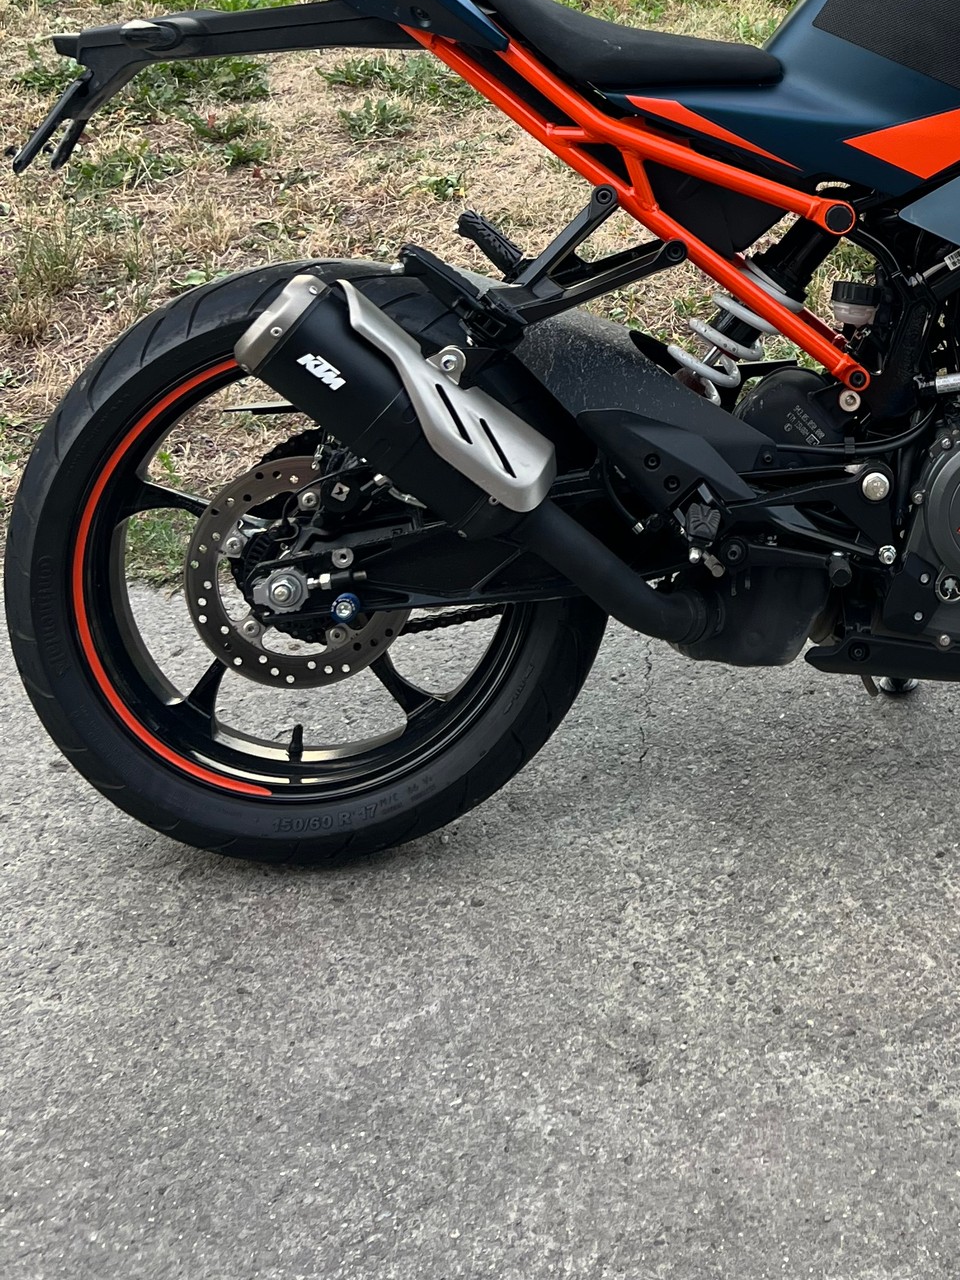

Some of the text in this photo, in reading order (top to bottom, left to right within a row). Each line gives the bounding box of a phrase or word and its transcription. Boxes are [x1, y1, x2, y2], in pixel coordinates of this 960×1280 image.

[296, 353, 347, 391] KTM
[272, 813, 333, 833] 150/60
[338, 810, 351, 827] R
[358, 803, 379, 820] 17
